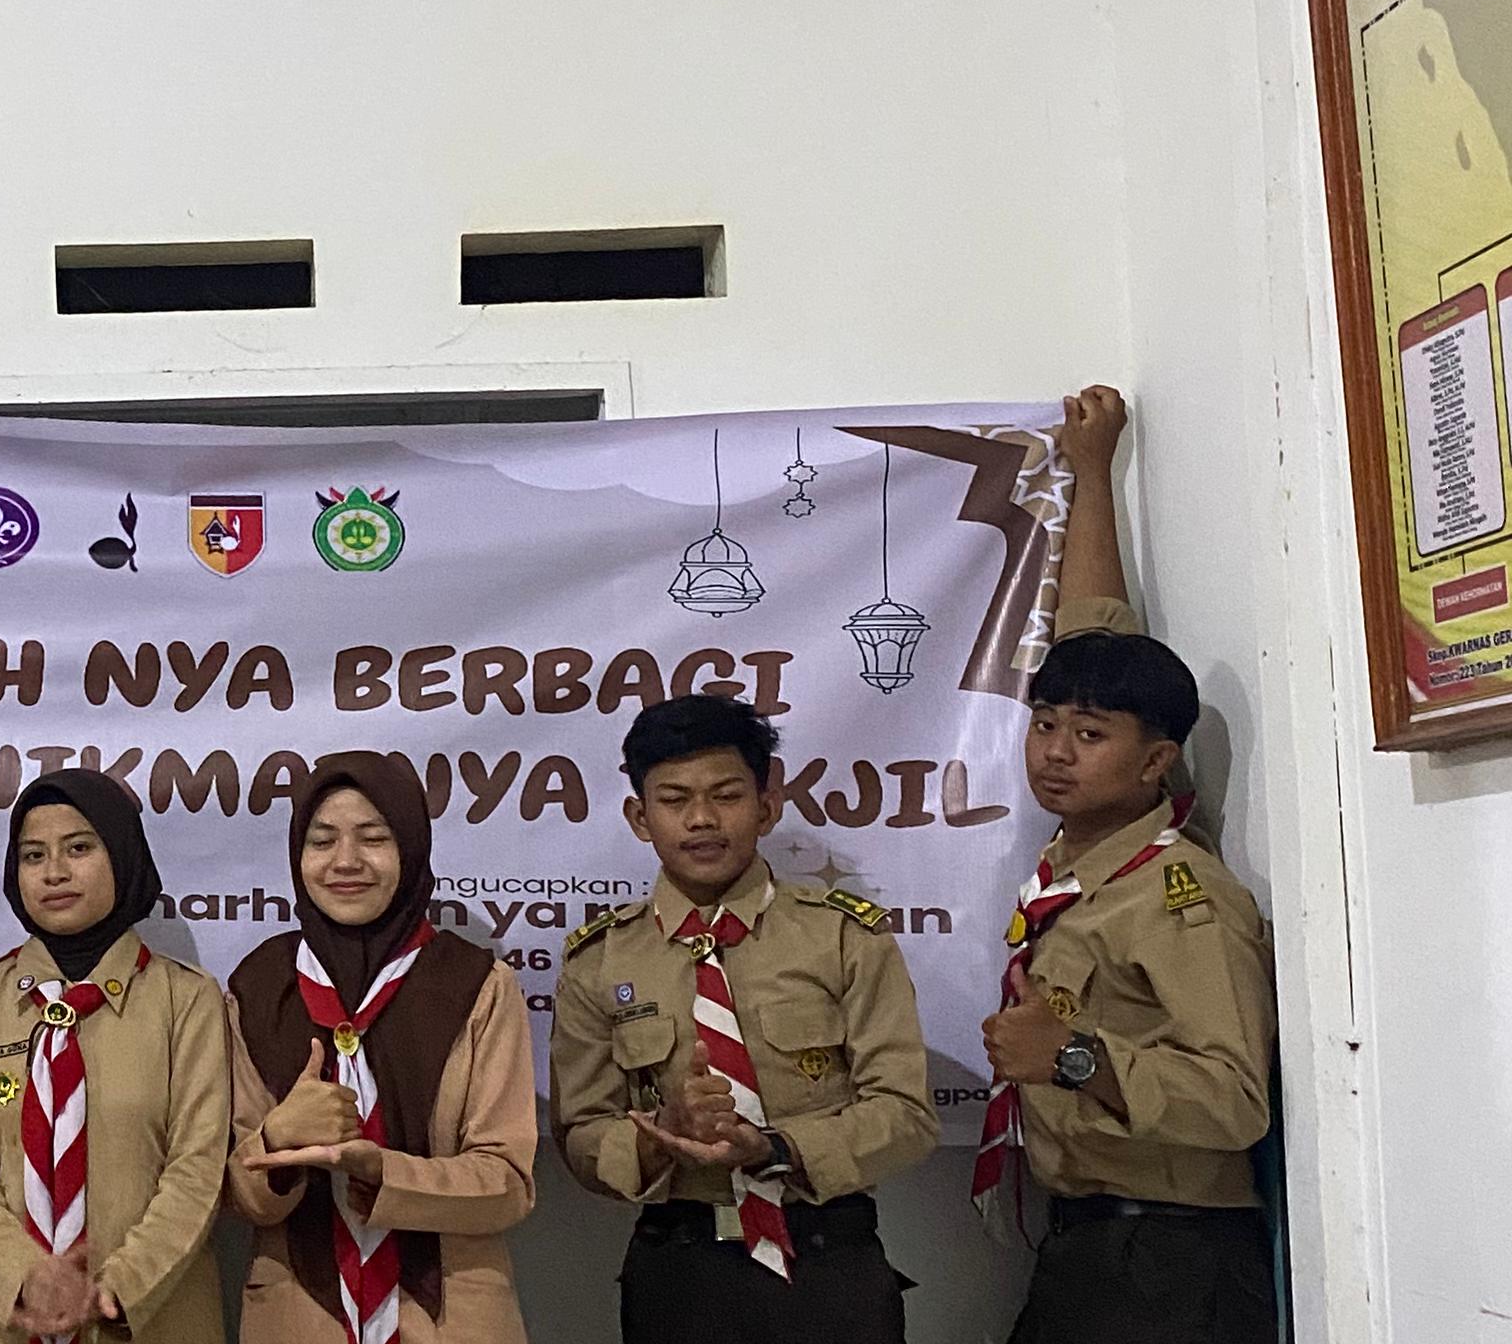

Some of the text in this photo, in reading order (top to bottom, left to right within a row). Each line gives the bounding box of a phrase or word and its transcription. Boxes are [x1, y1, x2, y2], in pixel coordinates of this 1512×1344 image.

[85, 640, 294, 712] NYA
[333, 645, 795, 719] BERBAGI
[482, 900, 567, 939] ya
